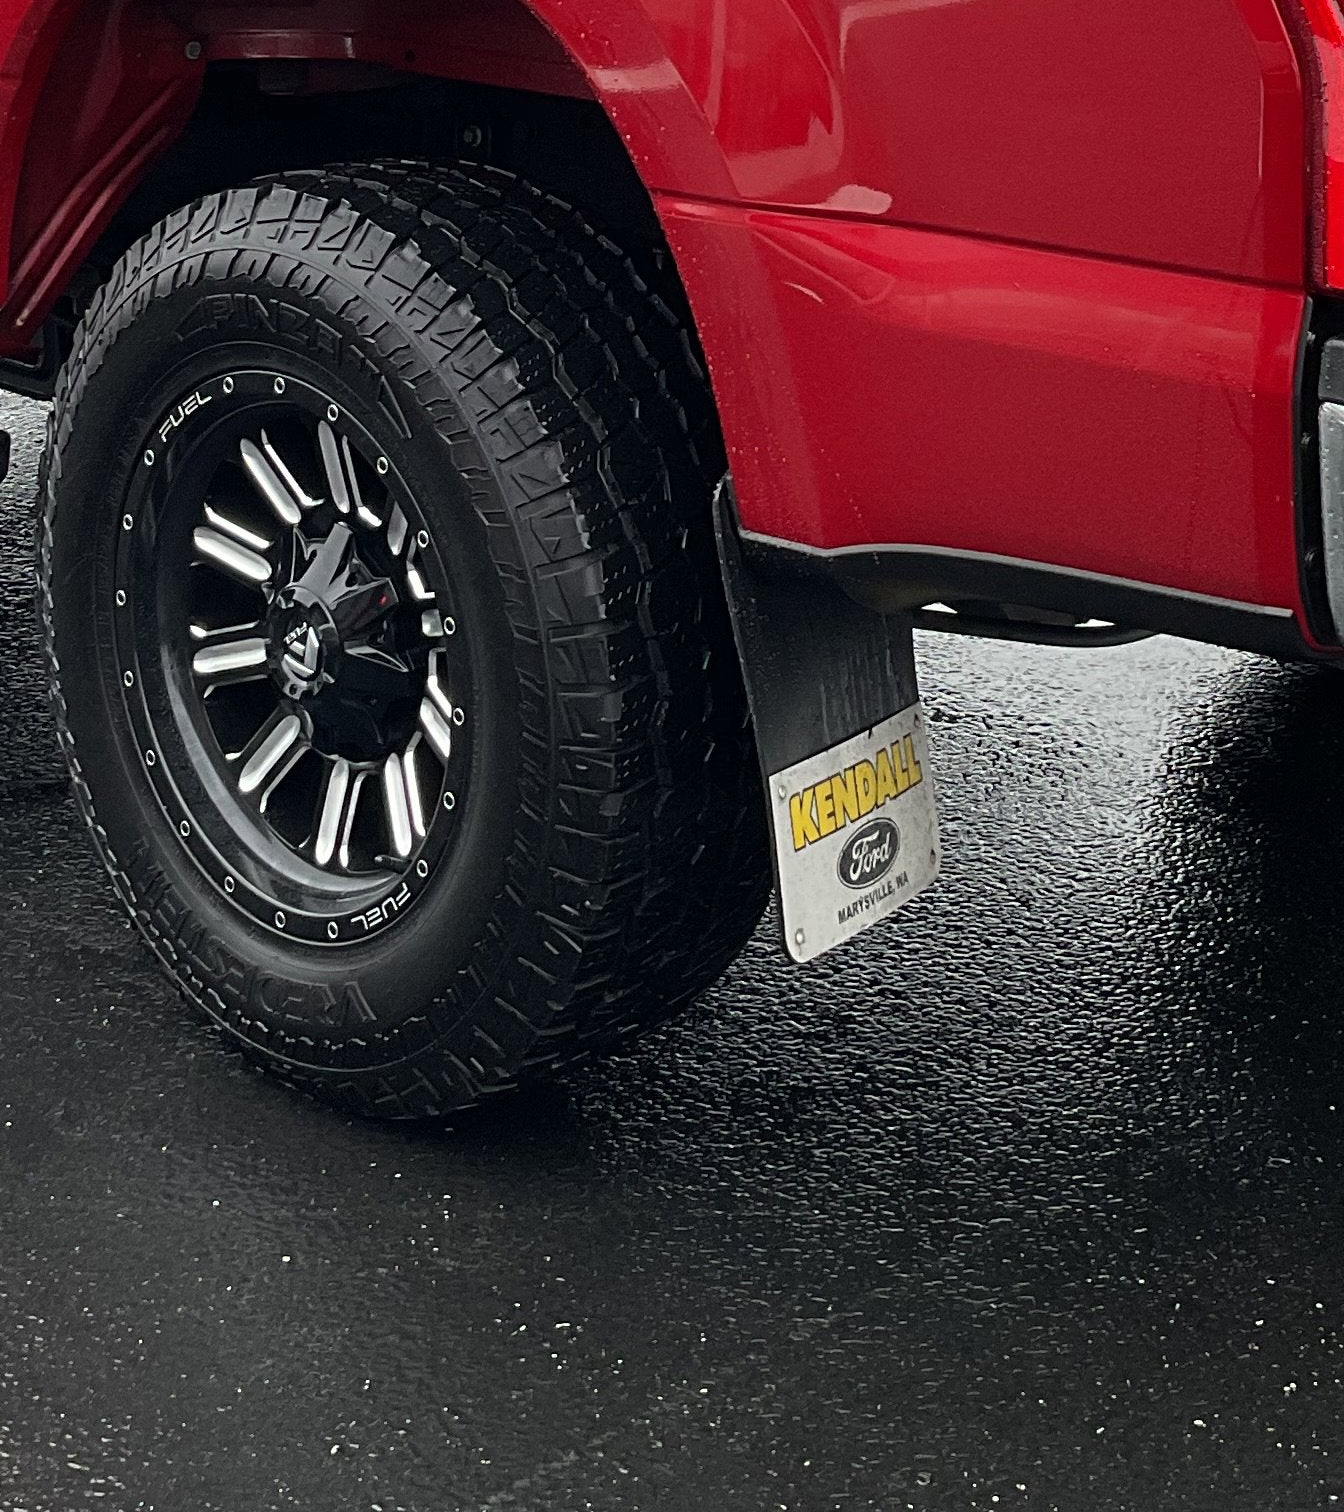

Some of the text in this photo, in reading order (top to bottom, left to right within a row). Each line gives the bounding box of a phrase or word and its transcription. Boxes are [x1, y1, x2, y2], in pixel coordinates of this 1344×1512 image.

[158, 391, 213, 442] FUEL
[789, 733, 923, 852] KENDALL
[849, 829, 892, 881] Ford
[350, 882, 412, 930] FUEL
[838, 870, 909, 925] MARYSVILLE, WA
